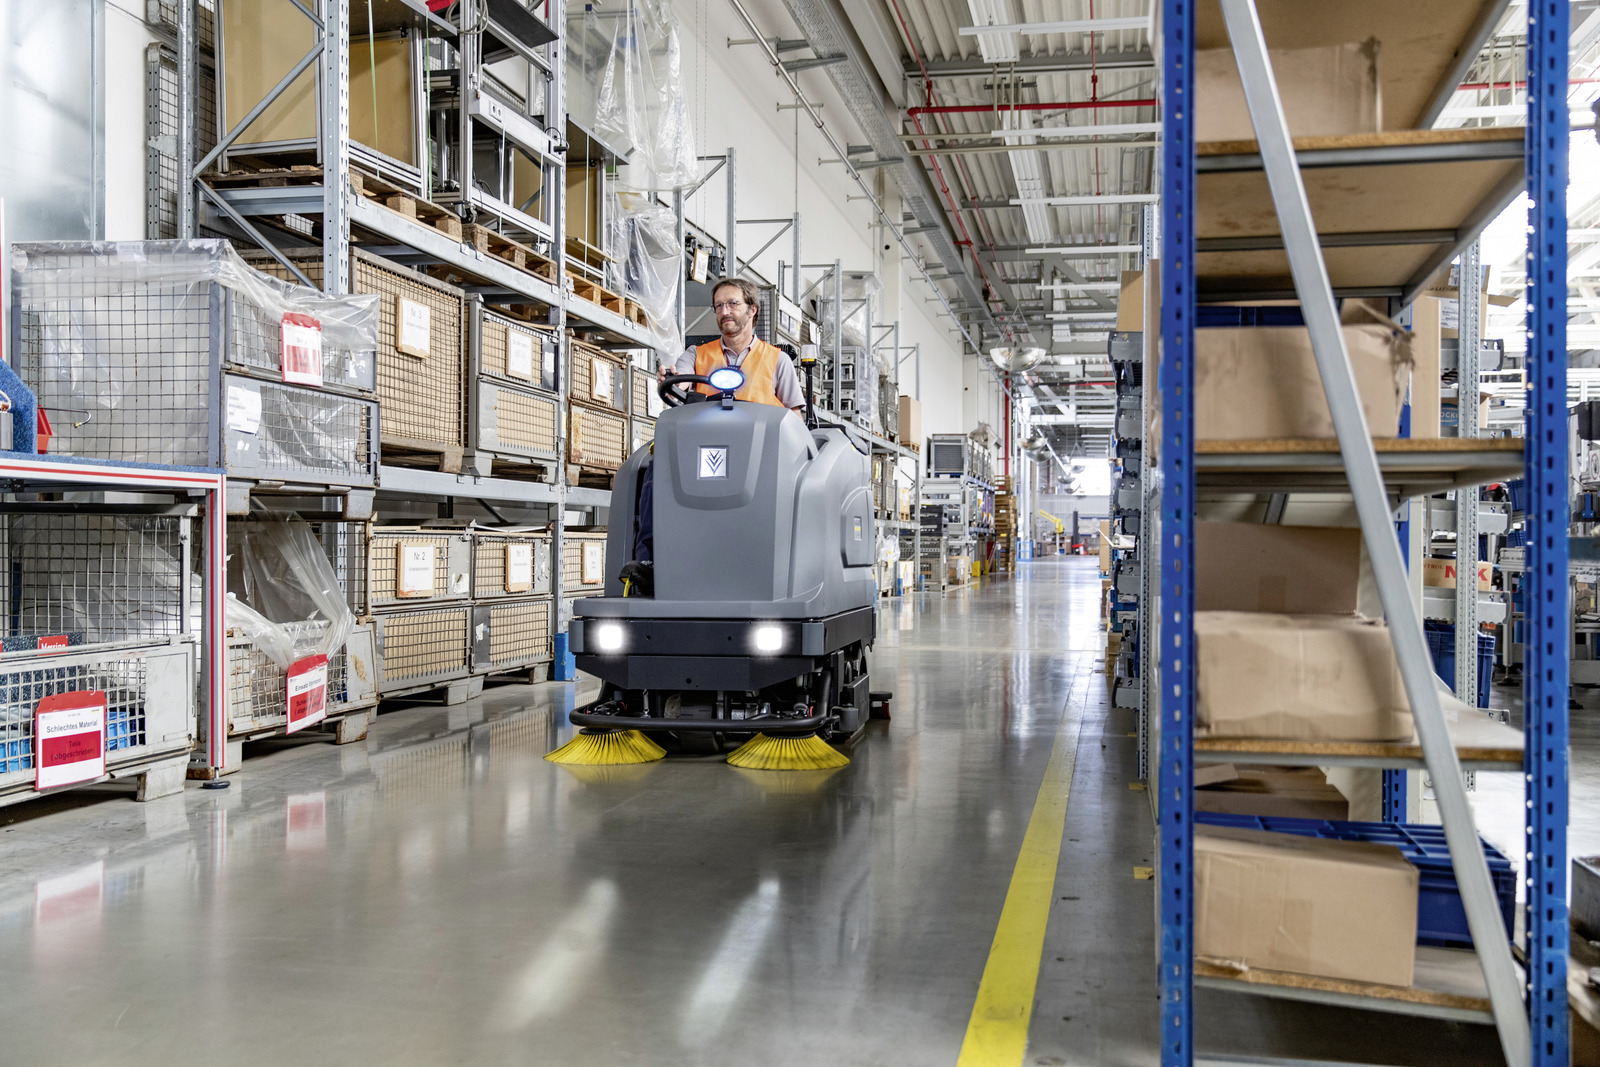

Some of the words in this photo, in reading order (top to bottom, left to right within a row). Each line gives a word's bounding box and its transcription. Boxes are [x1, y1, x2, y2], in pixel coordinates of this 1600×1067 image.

[1445, 565, 1488, 581] NK
[46, 723, 78, 734] Schlechtes
[78, 719, 98, 729] Material
